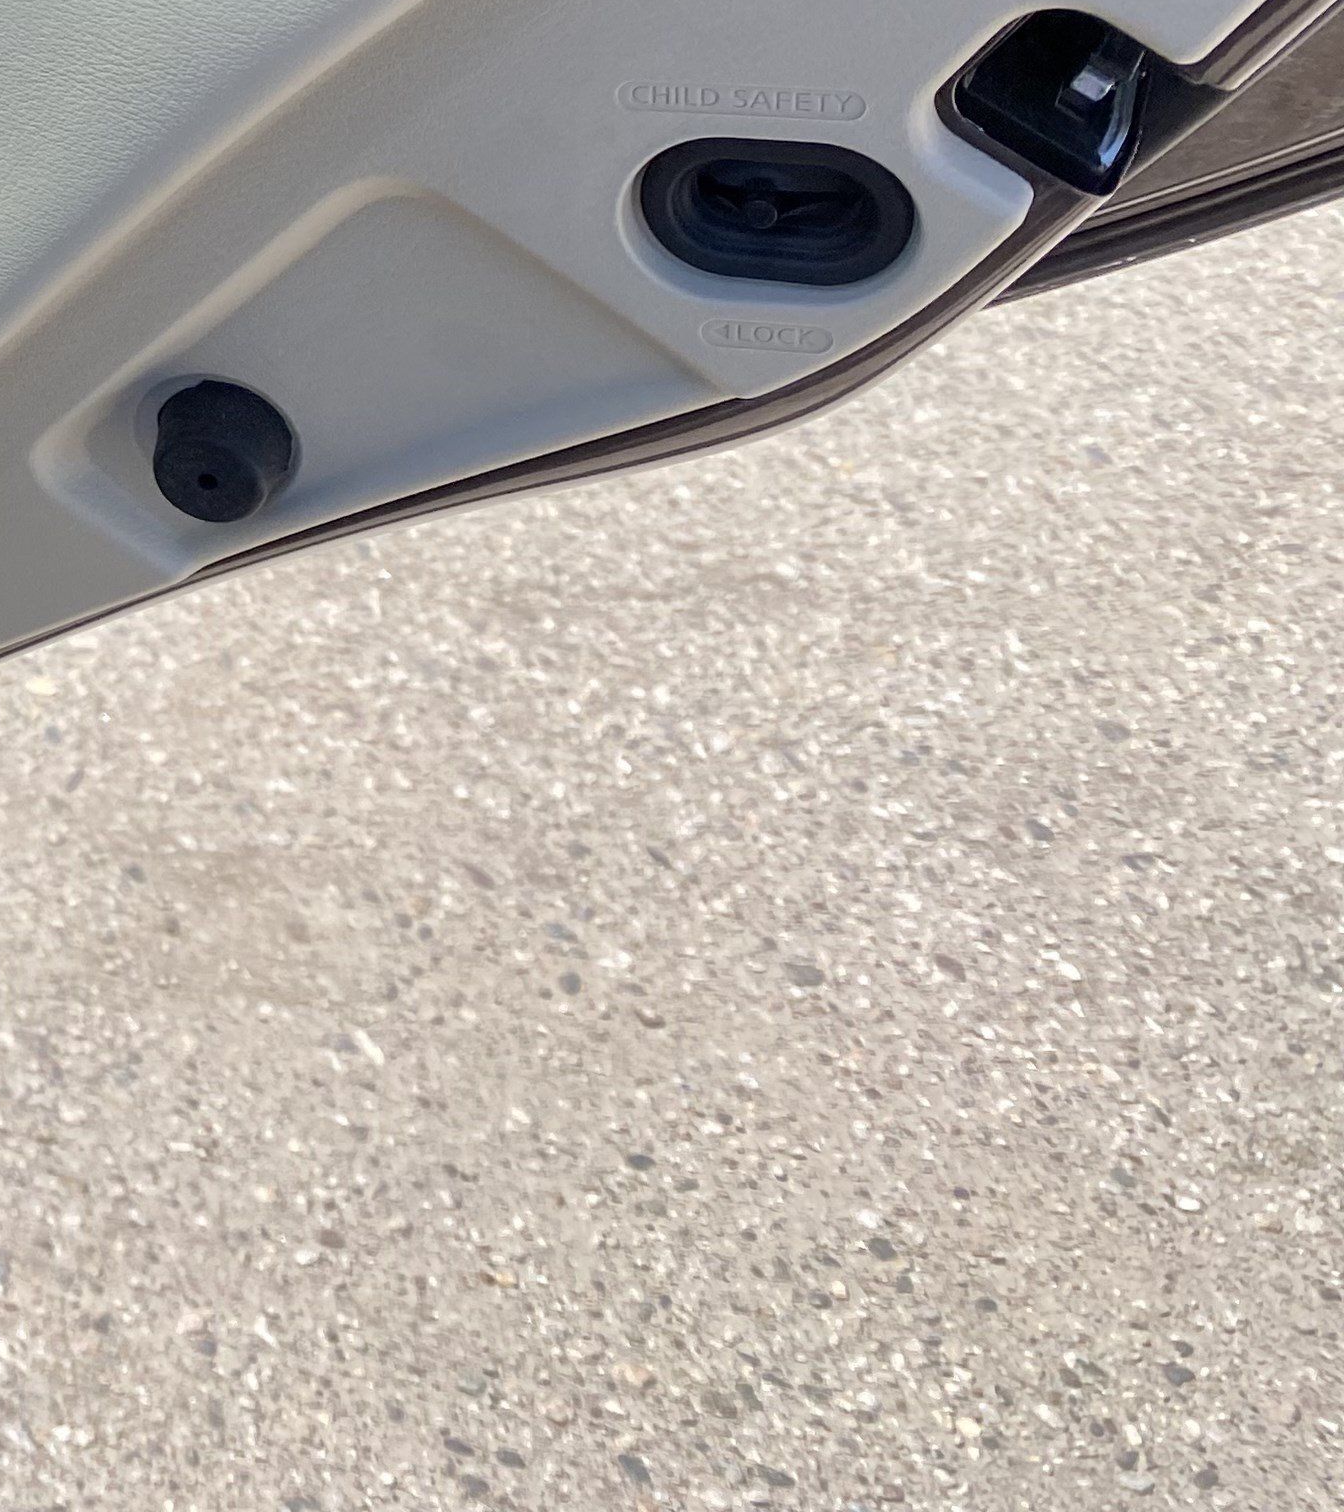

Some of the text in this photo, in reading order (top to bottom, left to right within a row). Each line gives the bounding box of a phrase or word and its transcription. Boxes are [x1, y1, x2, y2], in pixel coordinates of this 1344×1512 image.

[631, 85, 853, 114] CHILD SAFETY
[736, 324, 815, 345] LOCK
